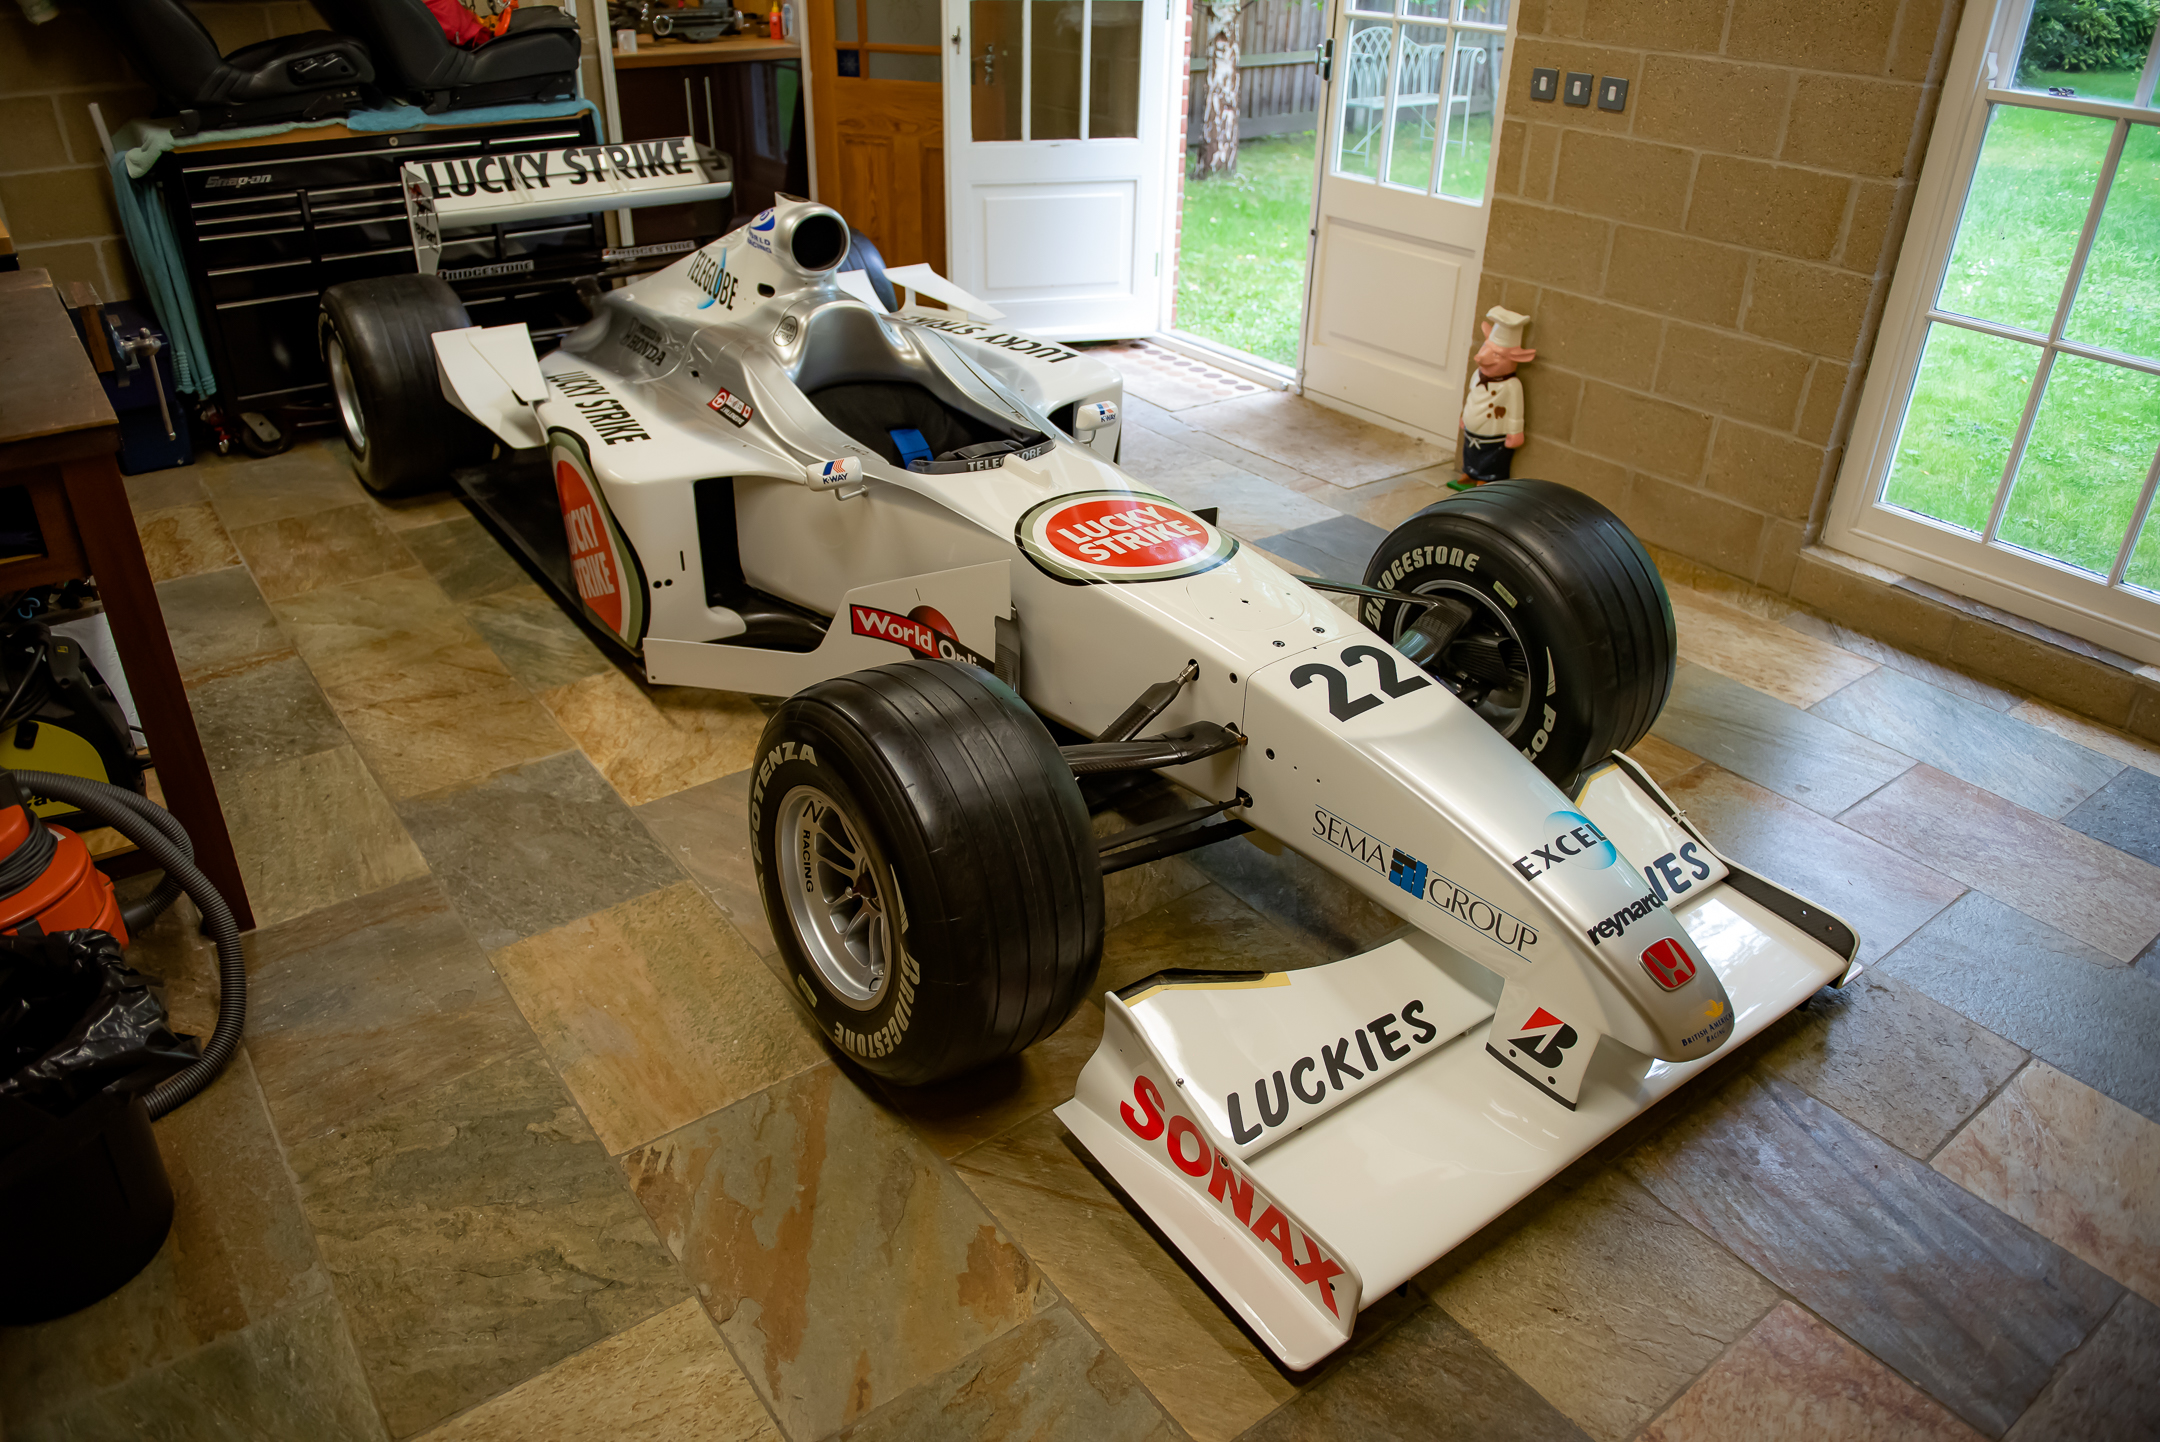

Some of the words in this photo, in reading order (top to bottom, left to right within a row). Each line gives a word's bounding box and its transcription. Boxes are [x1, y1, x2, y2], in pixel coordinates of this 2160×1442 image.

[205, 174, 272, 188] Snap-on
[422, 152, 551, 199] LUCKY
[562, 139, 694, 186] STRIKE
[687, 249, 739, 311] TELEGLOBE
[974, 333, 1079, 363] LUCKY
[545, 370, 611, 398] LUCKY
[574, 399, 652, 445] STRIKE
[1057, 505, 1168, 545] LUCKY
[1078, 519, 1202, 562] STRIKE
[856, 609, 933, 652] World
[1289, 644, 1433, 723] 22
[751, 741, 819, 865] POTENZA
[802, 829, 814, 894] RACING
[1312, 810, 1386, 873] SEMA
[1429, 878, 1538, 952] GROUP
[1512, 823, 1608, 882] EXCEL
[1586, 887, 1665, 946] reynard
[834, 943, 921, 1059] BRIDGESTONE
[1226, 999, 1437, 1146] LUCKIES
[1119, 1075, 1346, 1322] SONAX
